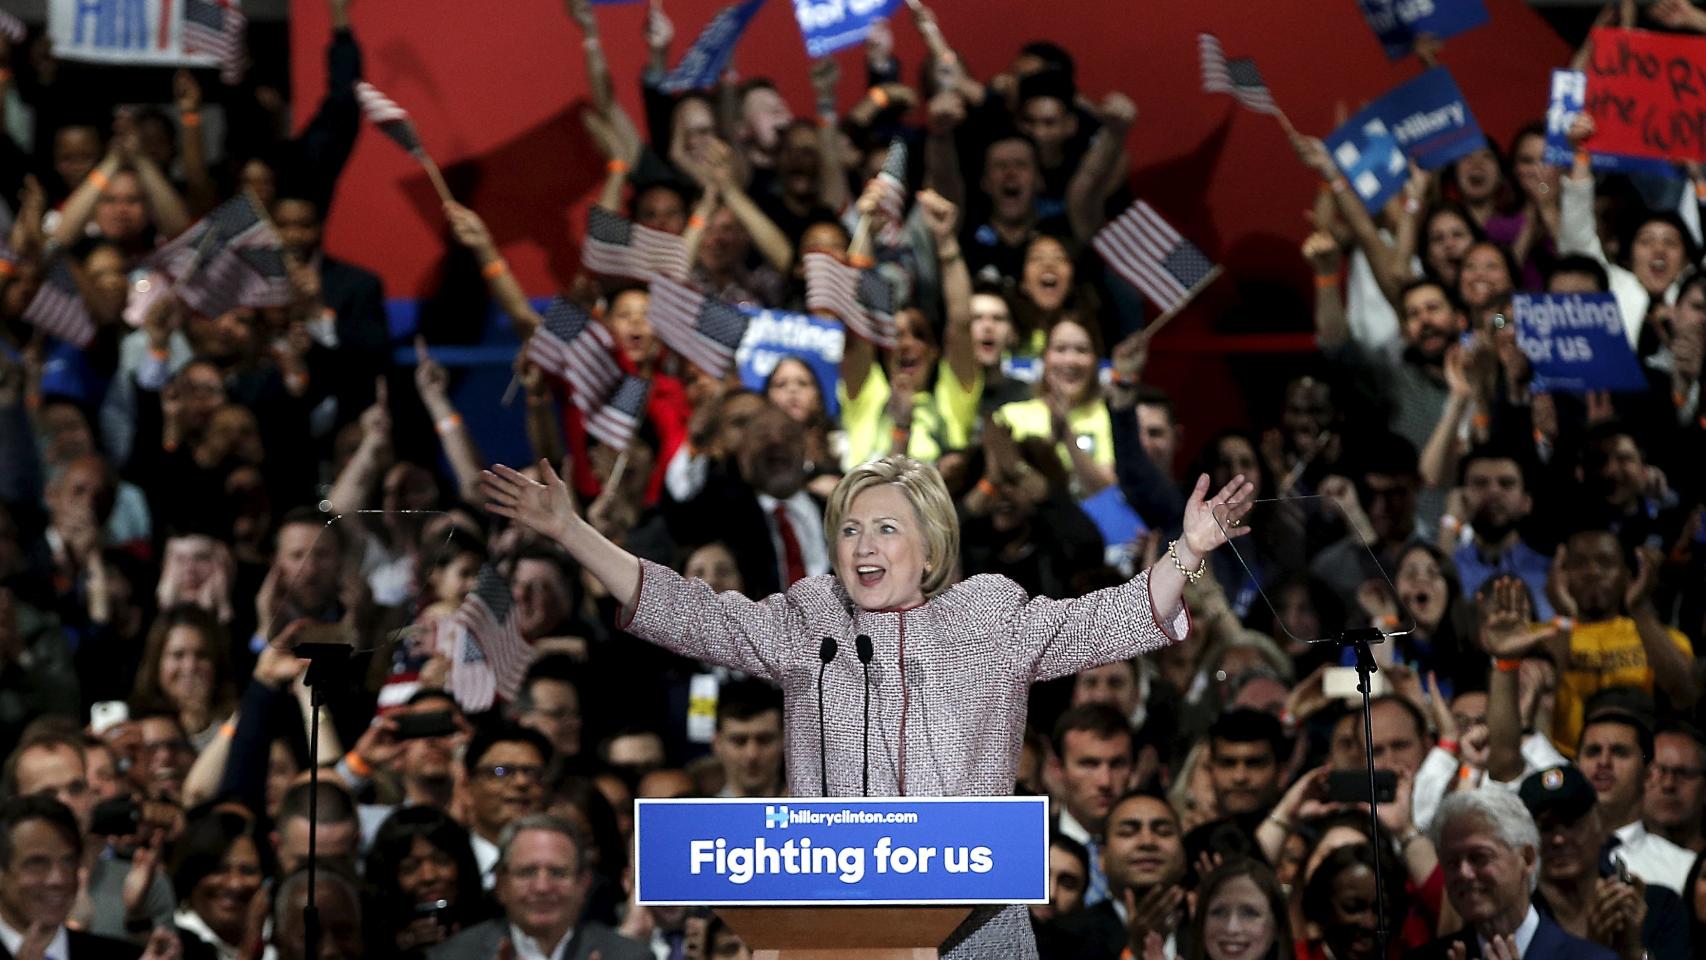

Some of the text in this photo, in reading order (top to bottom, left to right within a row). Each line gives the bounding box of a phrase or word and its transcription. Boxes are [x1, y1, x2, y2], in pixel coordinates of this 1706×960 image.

[1512, 294, 1621, 335] Fighting
[1556, 336, 1593, 361] us
[790, 810, 918, 826] hillaryclinton.com
[690, 837, 993, 884] Fighting for us
